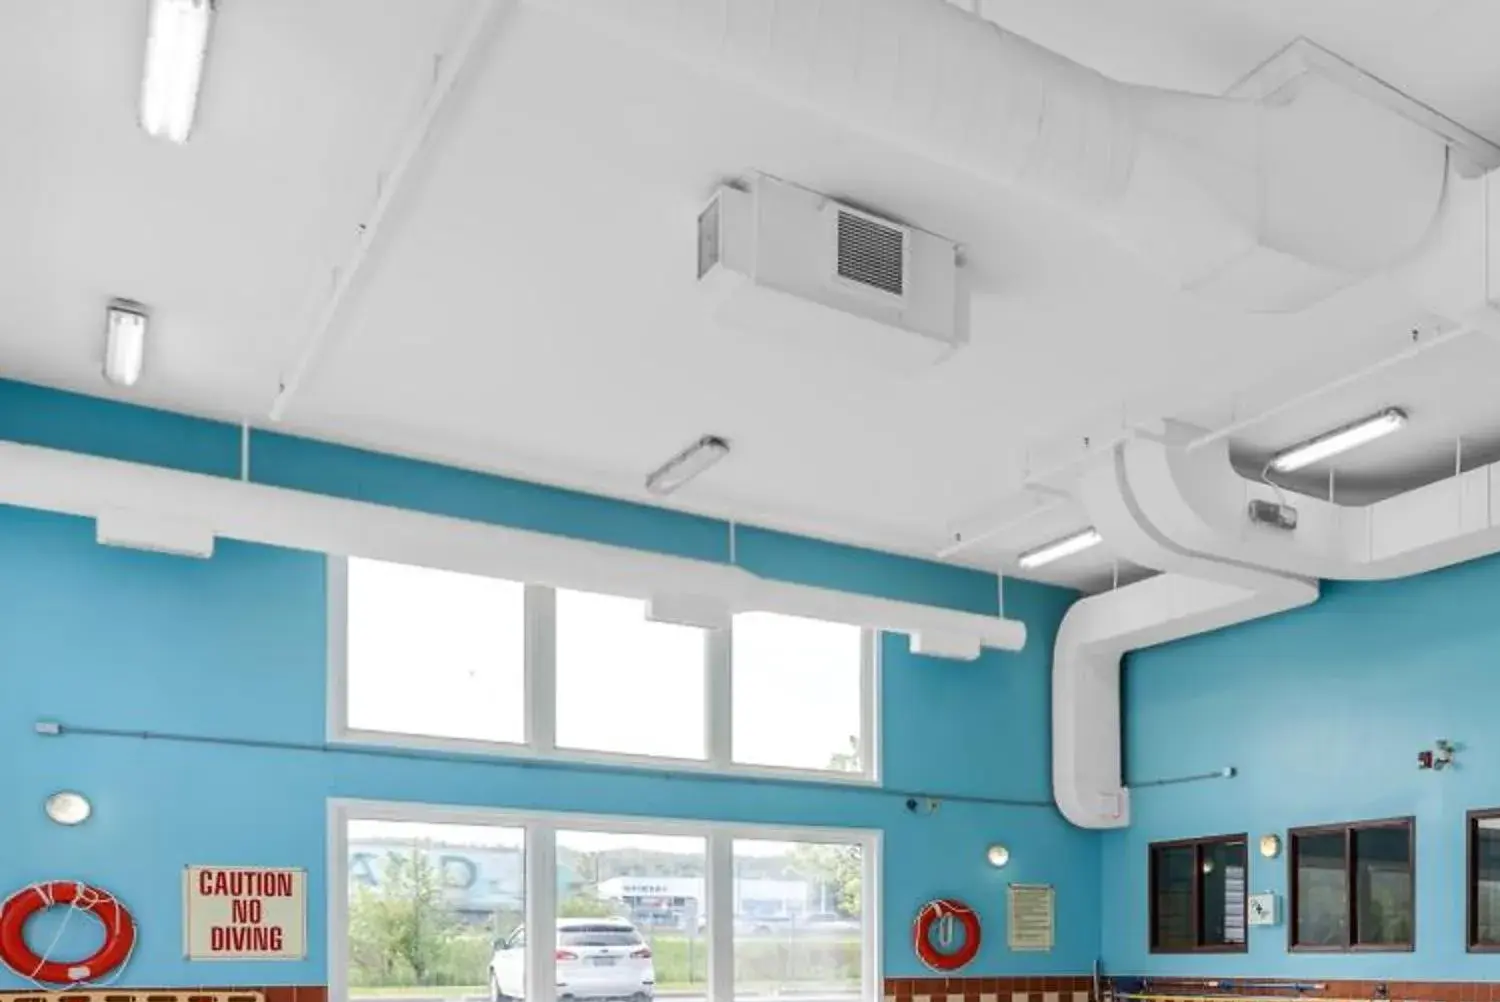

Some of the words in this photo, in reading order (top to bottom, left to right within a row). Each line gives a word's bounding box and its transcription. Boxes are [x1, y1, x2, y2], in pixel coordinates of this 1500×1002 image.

[199, 869, 294, 897] CAUTION
[231, 898, 262, 924] NO
[210, 926, 284, 951] DIVING
